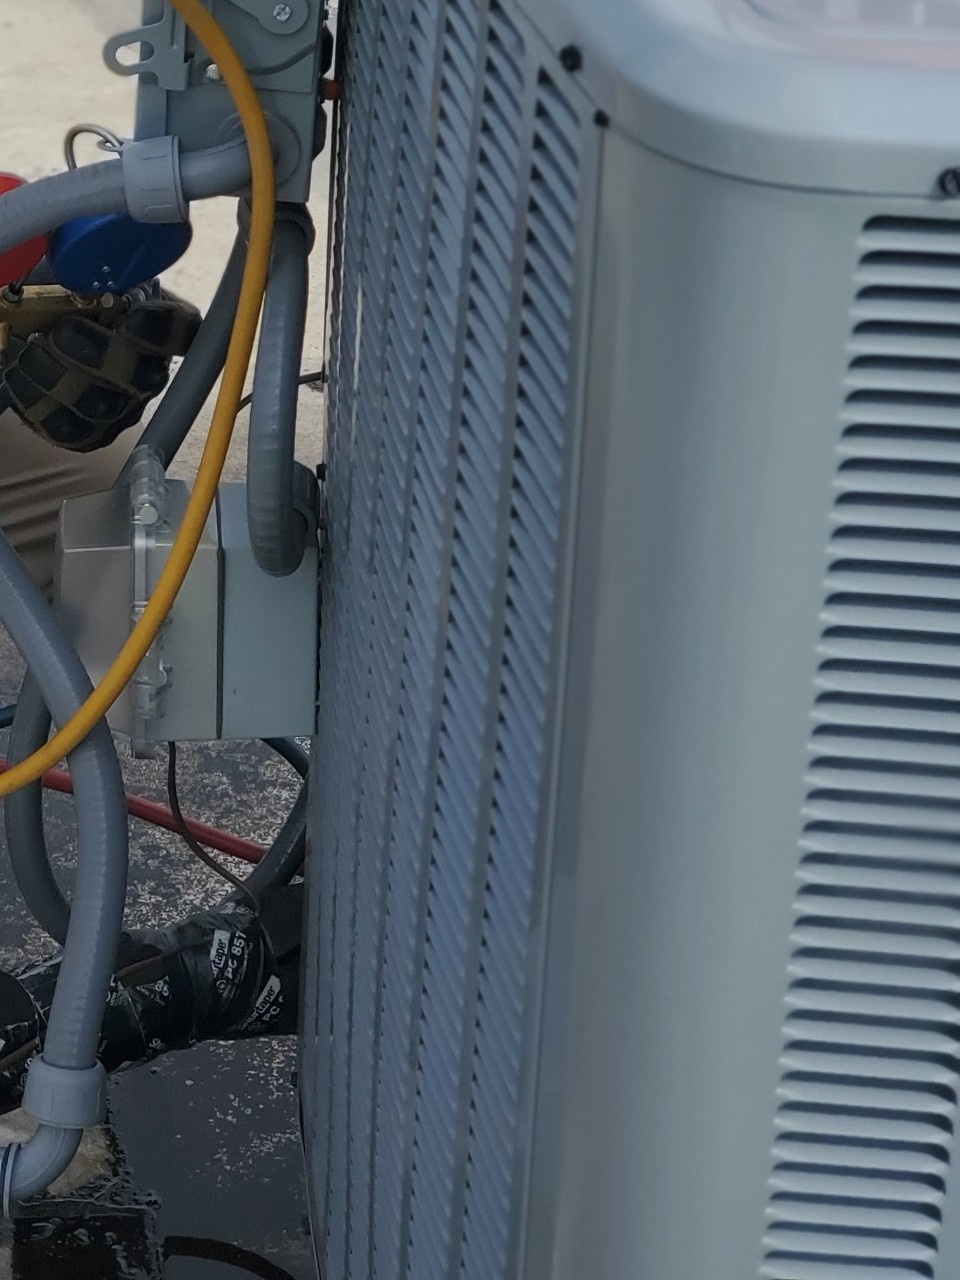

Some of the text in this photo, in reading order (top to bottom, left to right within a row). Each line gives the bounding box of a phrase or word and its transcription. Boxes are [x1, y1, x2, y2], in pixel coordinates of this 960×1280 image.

[224, 958, 238, 979] PC
[231, 929, 247, 956] 857
[261, 1005, 281, 1021] PC
